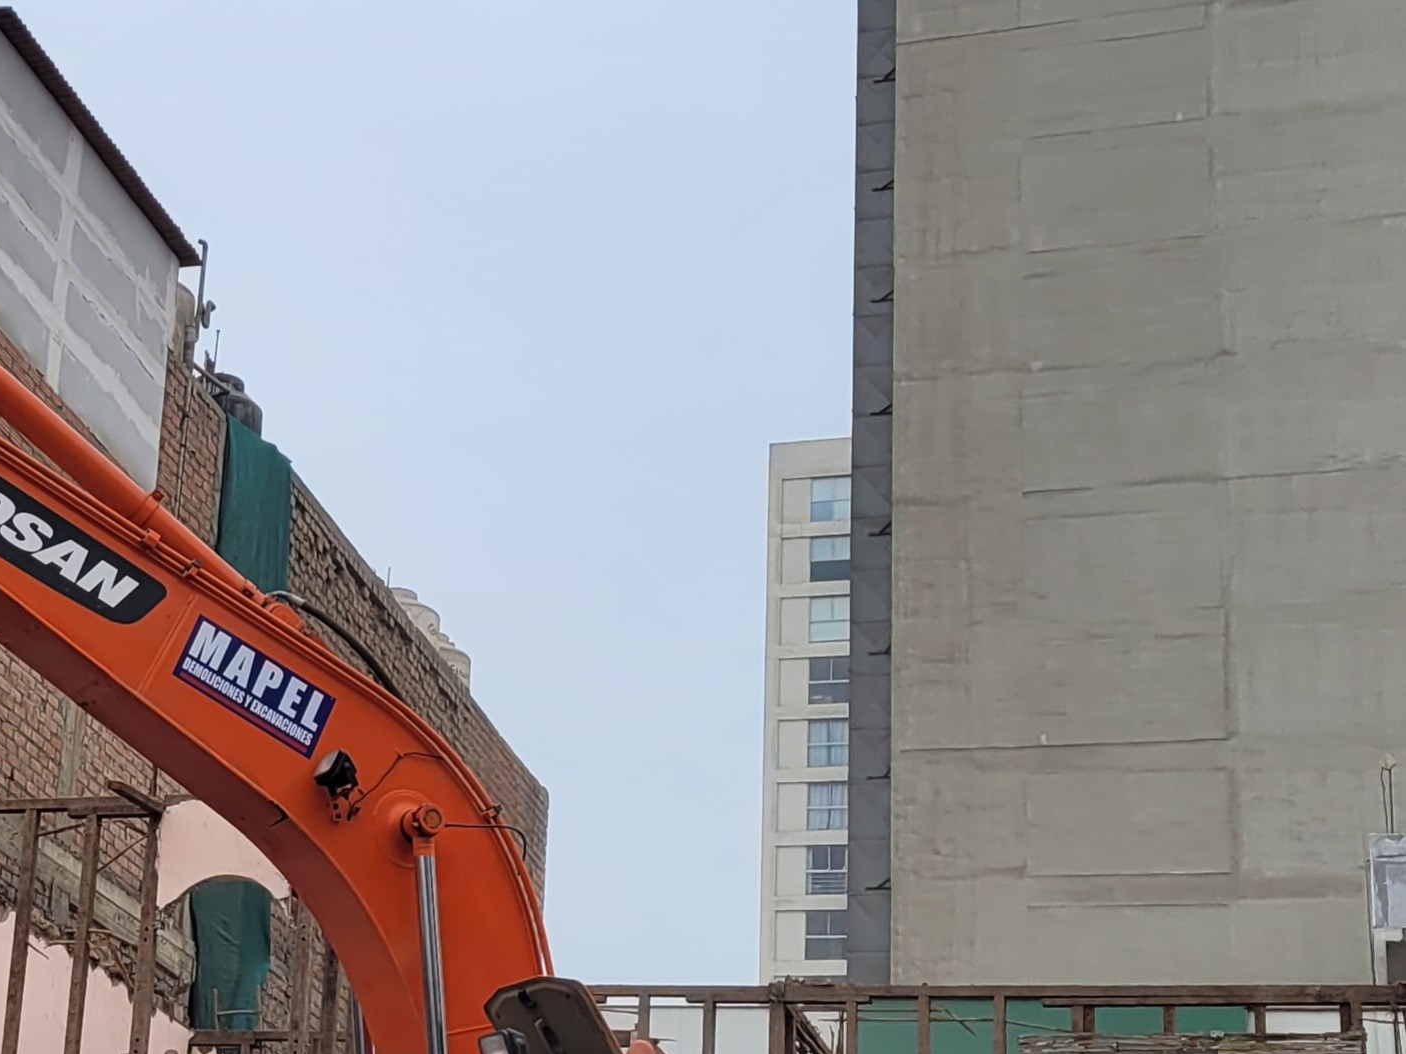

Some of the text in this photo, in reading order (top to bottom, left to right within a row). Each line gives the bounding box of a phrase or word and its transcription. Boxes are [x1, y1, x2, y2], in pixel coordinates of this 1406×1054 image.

[182, 656, 314, 747] DEMOLICIONES Y EXCAVACIONES
[188, 620, 325, 732] MAPEL
